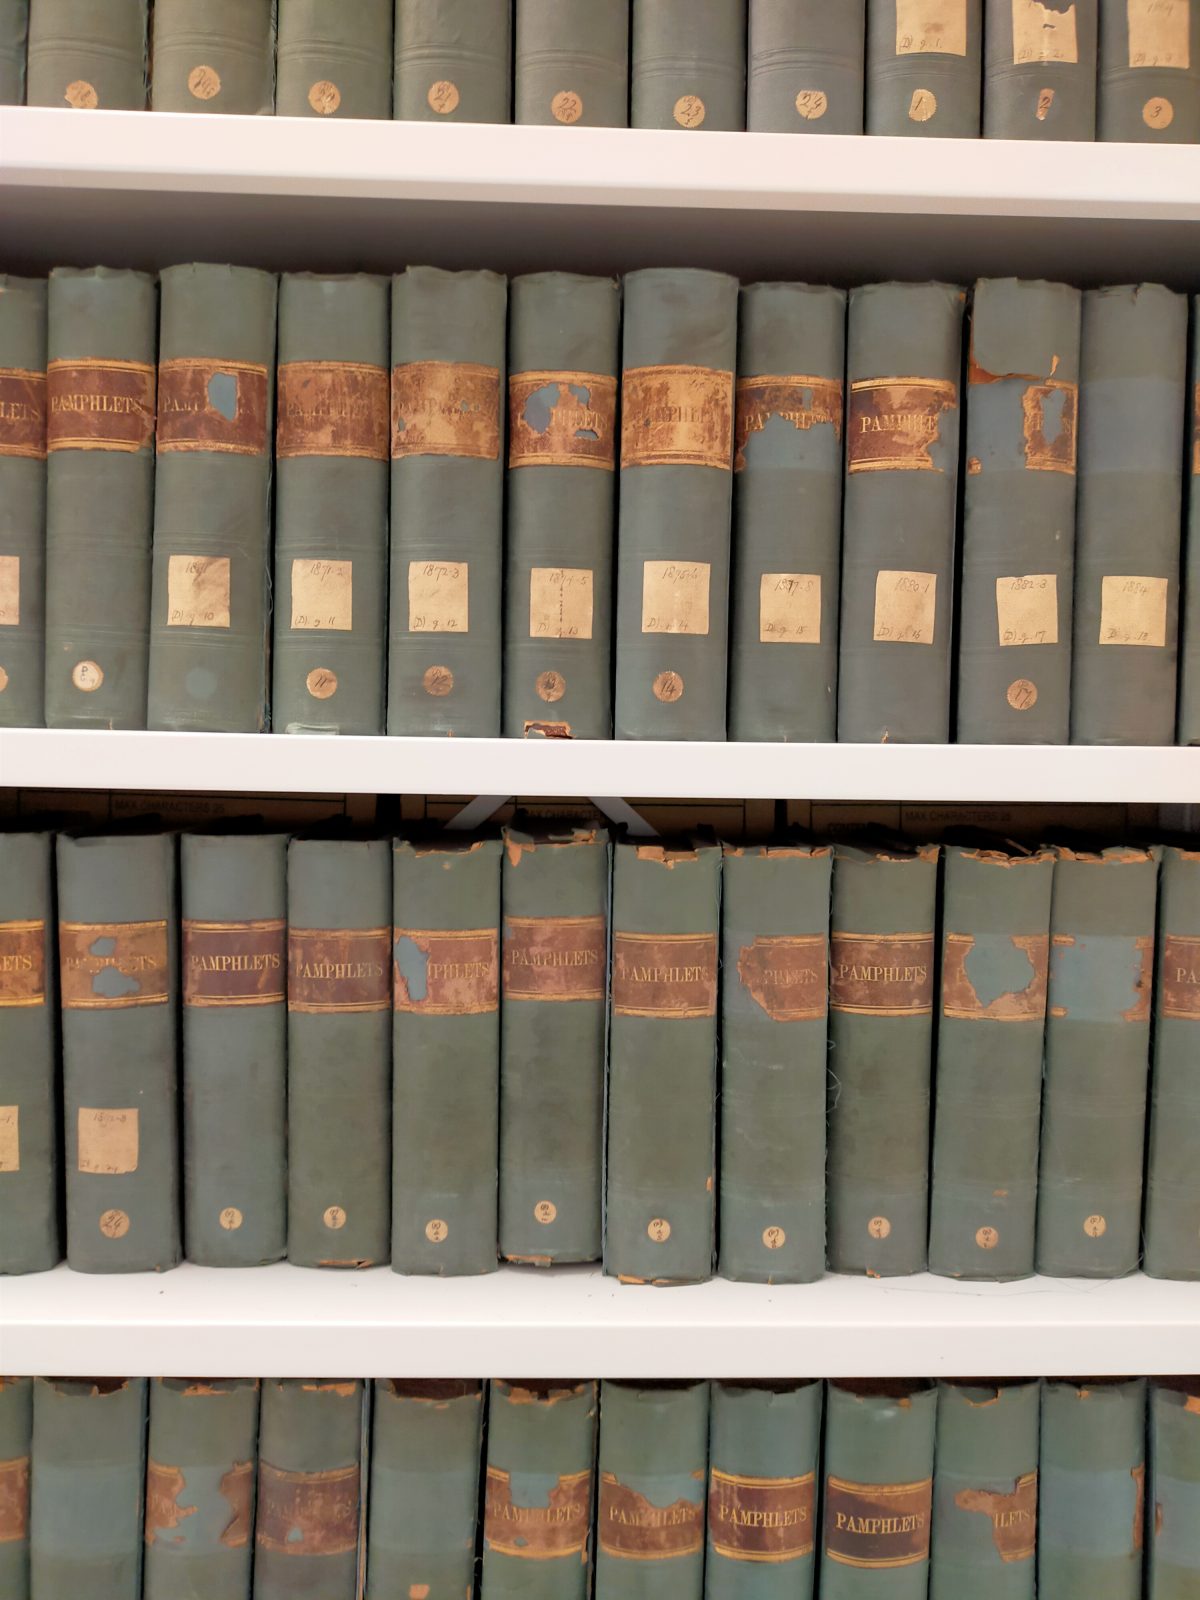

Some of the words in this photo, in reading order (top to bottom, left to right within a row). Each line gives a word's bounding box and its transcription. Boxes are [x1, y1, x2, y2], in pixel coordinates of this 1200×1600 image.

[51, 393, 144, 414] PAMPHLETS
[191, 953, 281, 972] PAMPHLETS
[511, 949, 599, 968] PAMPHLETS
[295, 962, 384, 980] PAMPHLETS
[621, 966, 709, 984] PAMPHLETS
[839, 964, 928, 983] PAMPHLETS
[720, 1504, 808, 1529] PAMPHLETS
[836, 1511, 926, 1535] PAMPHLETS
